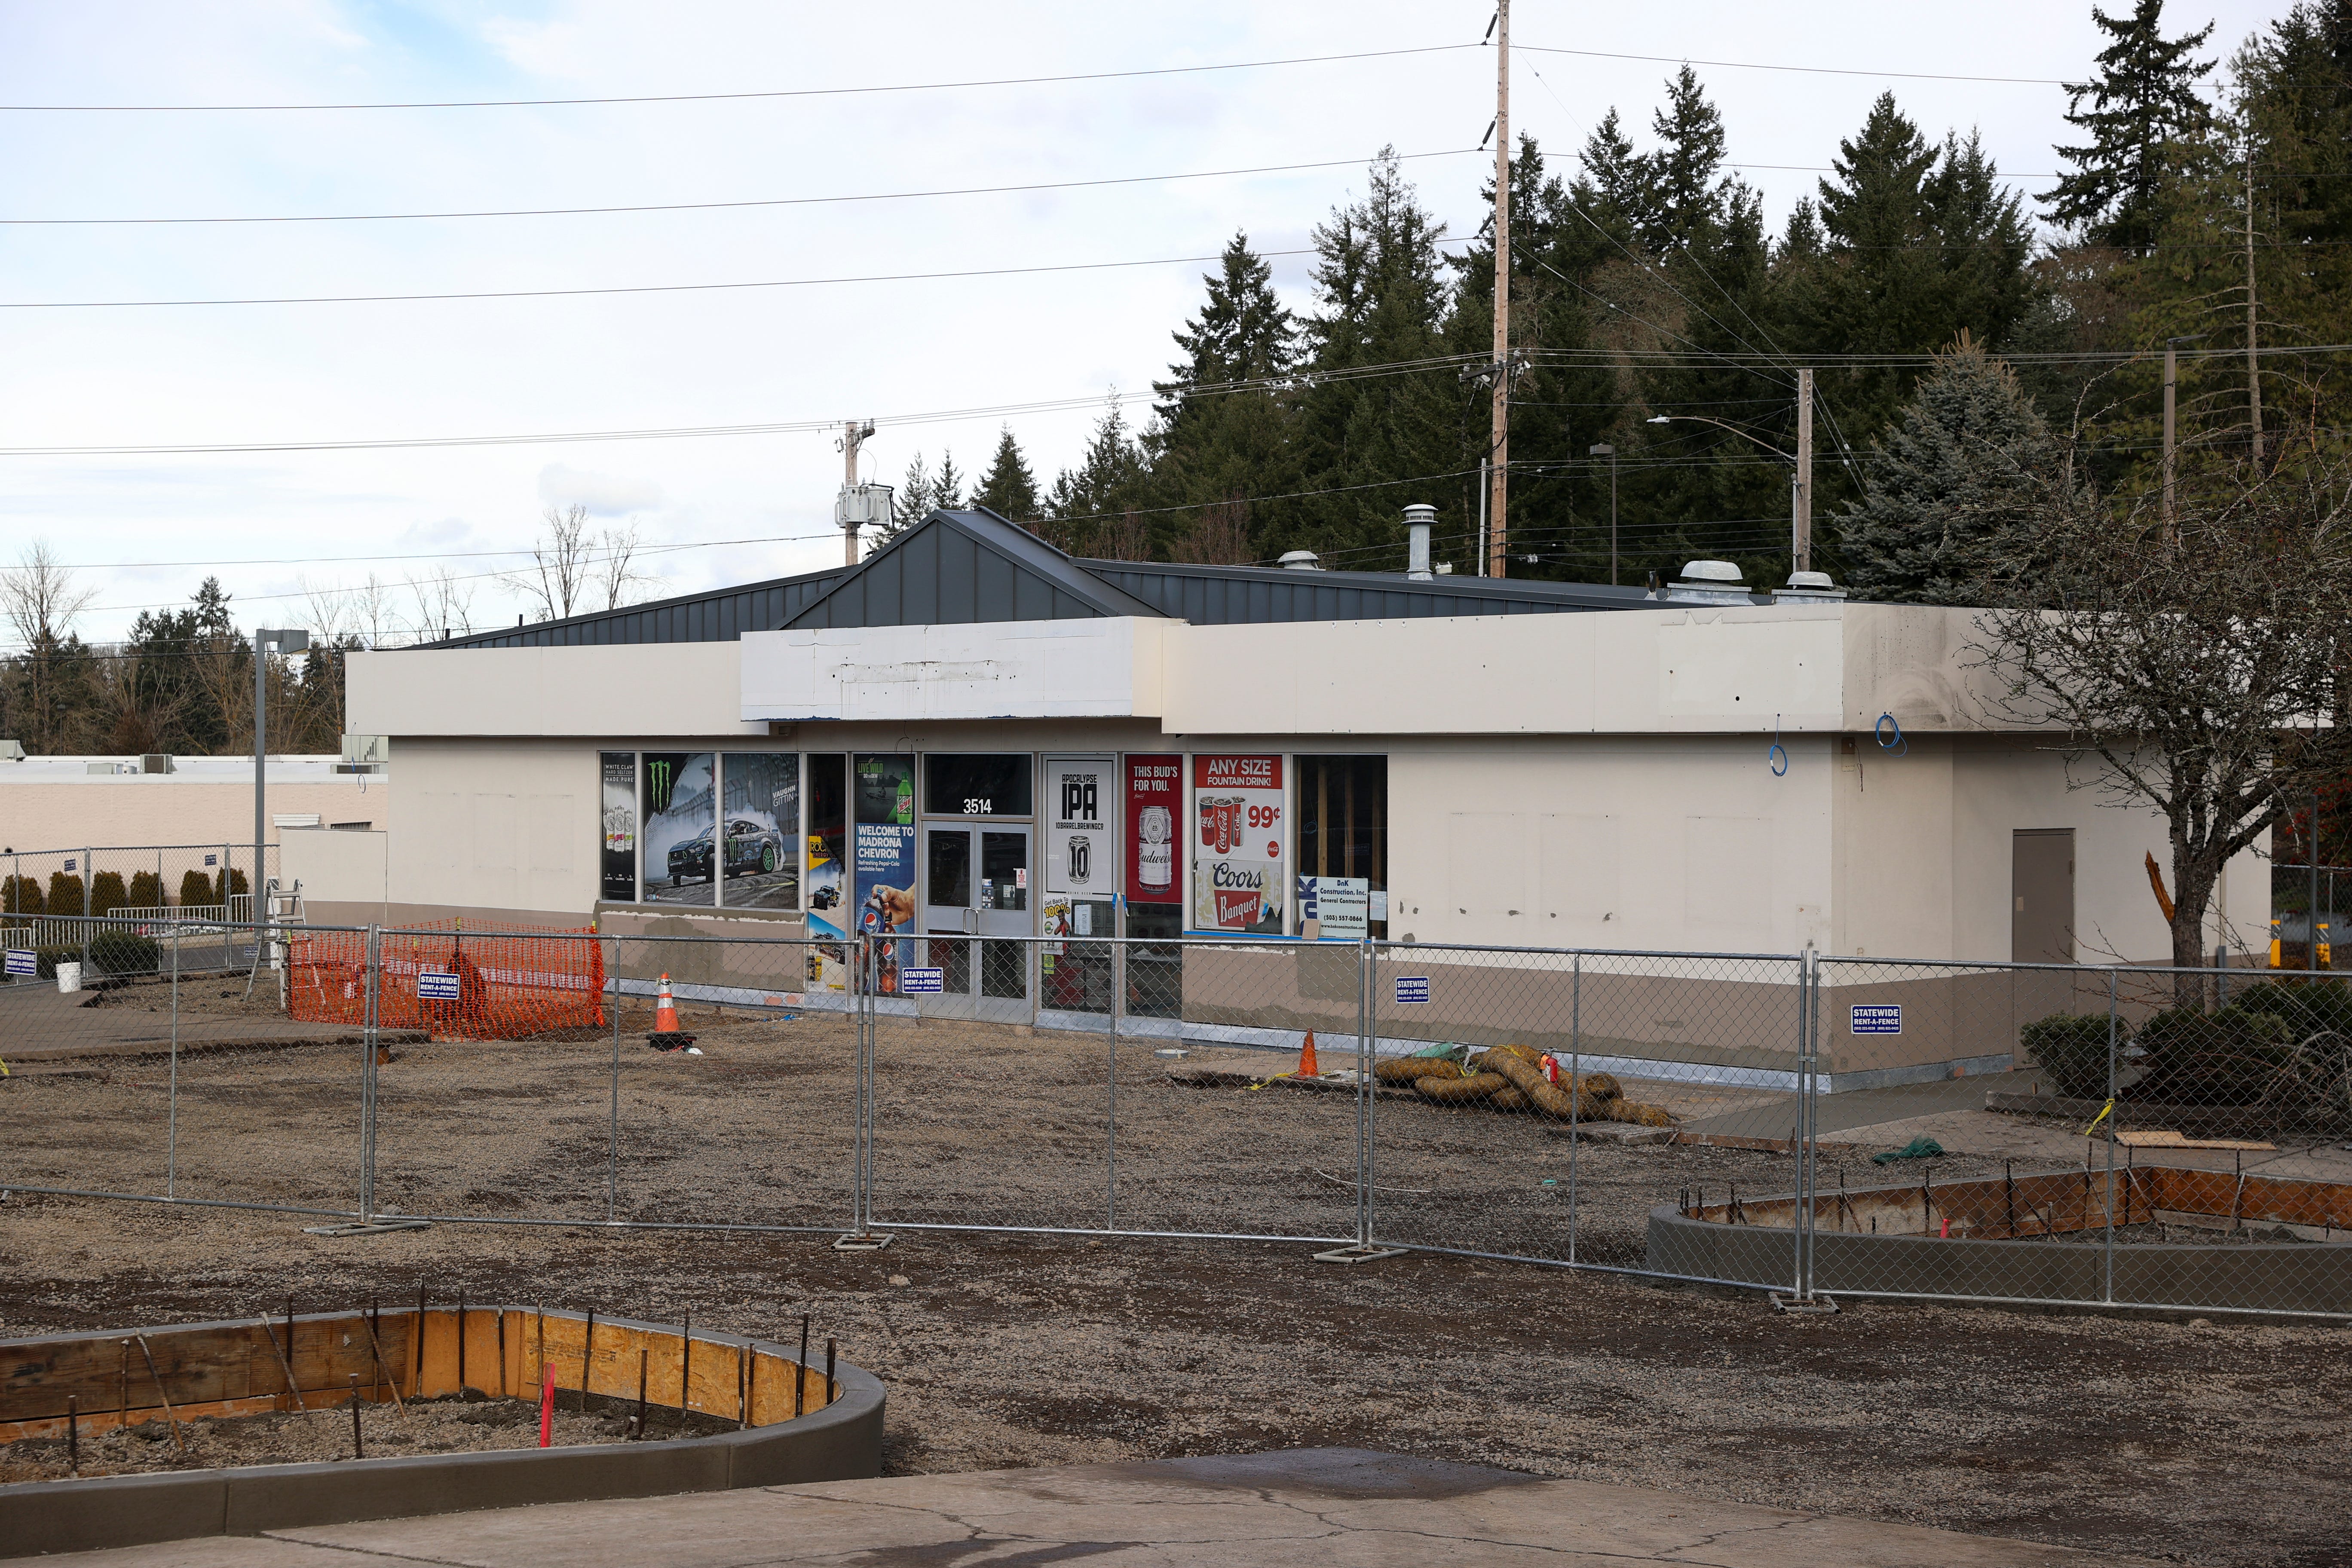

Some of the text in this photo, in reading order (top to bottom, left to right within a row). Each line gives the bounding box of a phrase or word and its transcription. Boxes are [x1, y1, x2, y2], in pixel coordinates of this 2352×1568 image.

[858, 763, 883, 773] LIVE WILD
[1134, 766, 1178, 778] THIS BUD'S
[1208, 759, 1271, 775] ANY SIZE
[1062, 774, 1097, 783] APOCALYPSE
[1207, 777, 1271, 786] FOUNTAIN DRINK!
[1134, 780, 1170, 791] FOR YOU.
[772, 784, 796, 799] VAUGHN
[773, 792, 794, 807] GITTIN
[1062, 784, 1097, 820] IPA
[964, 799, 992, 814] 3514
[858, 826, 914, 837] WELCOME TO
[1217, 808, 1228, 850] Coca-Cola
[810, 842, 827, 852] ROC
[858, 836, 902, 848] MADRONA
[858, 848, 899, 859] CHEVRON
[1071, 845, 1088, 877] 10
[1213, 862, 1263, 889] Coors
[1320, 888, 1355, 896] Construction,
[1044, 902, 1071, 919] 100%
[1220, 895, 1258, 923] Banquet
[8, 952, 36, 962] STATEWIDE
[7, 960, 35, 968] RENT-A-FENCE
[421, 976, 458, 985] STATEWIDE
[1853, 1009, 1899, 1017] STATEWIDE
